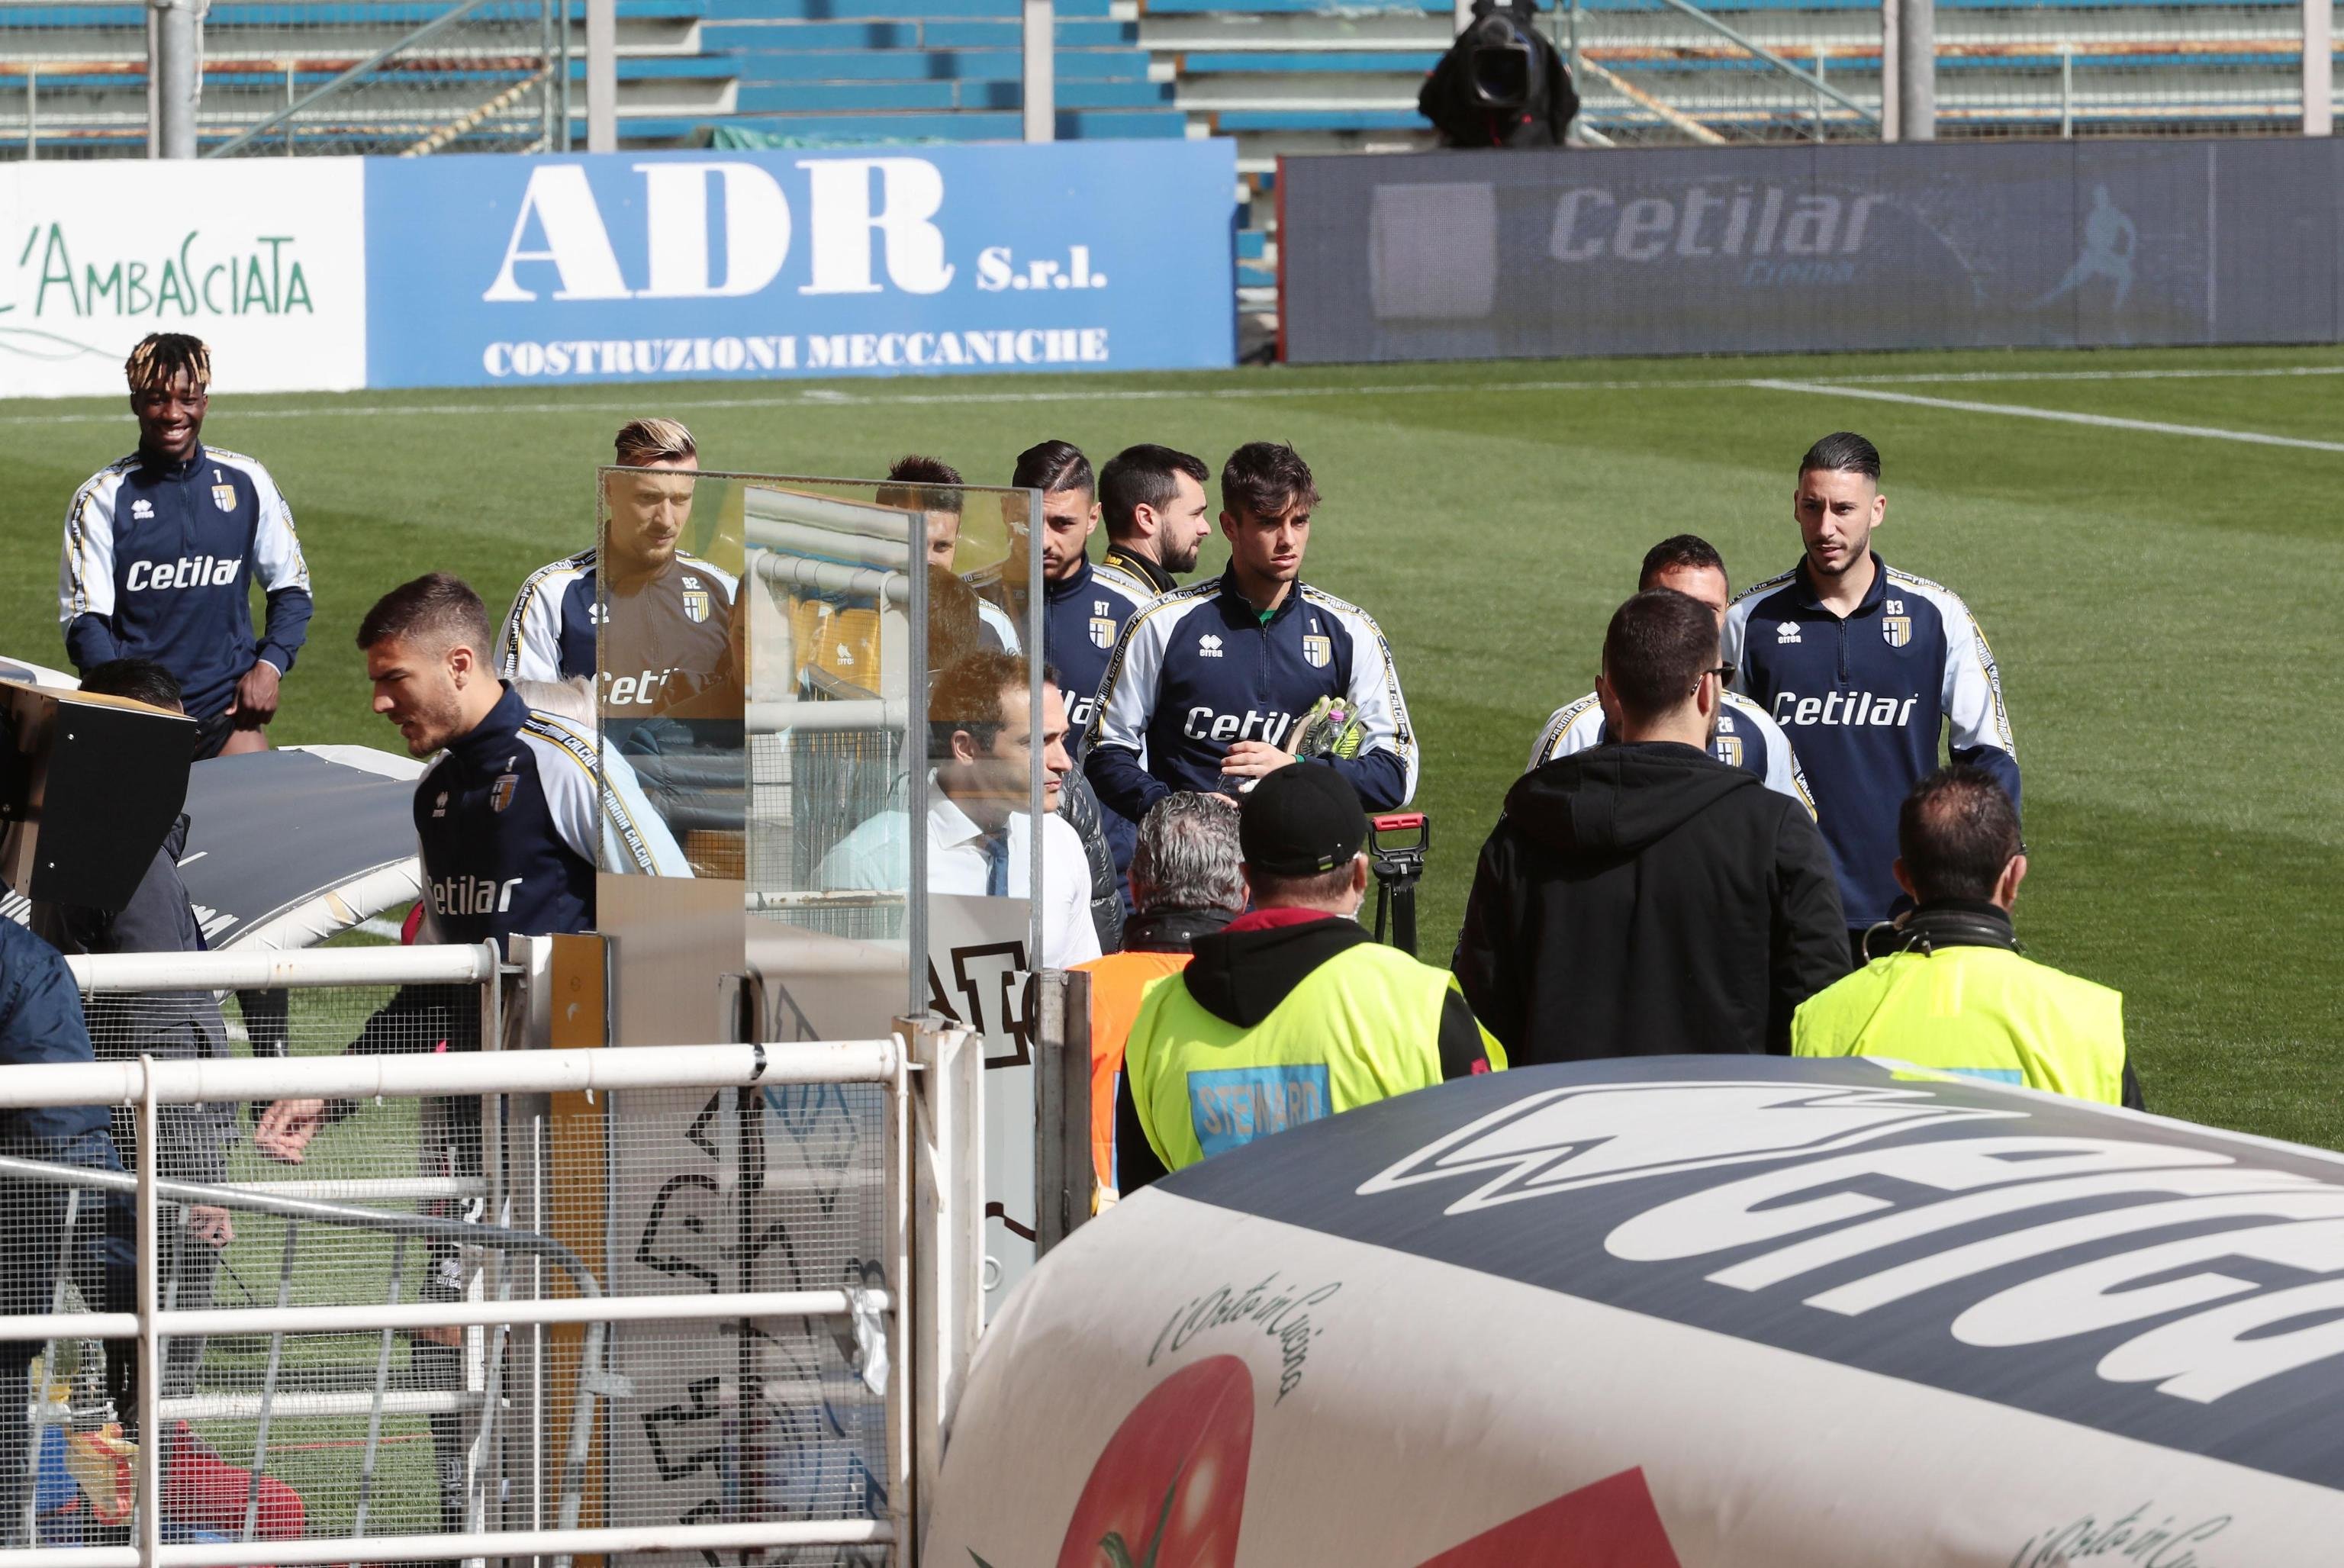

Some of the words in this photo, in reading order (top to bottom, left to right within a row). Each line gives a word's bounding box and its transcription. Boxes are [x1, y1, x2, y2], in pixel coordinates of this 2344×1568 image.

[482, 156, 955, 303] ADR
[976, 245, 1109, 292] S.r.l.
[1550, 186, 1888, 262] Cetilar
[0, 221, 314, 317] 'AMBASCIATA
[482, 334, 797, 378] COSTRUZIONI
[807, 327, 1109, 369] MECCANICHE
[213, 469, 223, 483] 1
[681, 577, 700, 590] 92
[1093, 600, 1109, 617] 97
[1309, 618, 1318, 633] 1
[1886, 600, 1904, 615] 93
[1199, 648, 1223, 658] errea
[1550, 708, 1577, 741] PARMA
[1718, 716, 1735, 733] 26
[1772, 689, 1919, 726] Cetilar
[1184, 707, 1302, 746] Cetil
[623, 827, 652, 868] CALCIO
[427, 874, 523, 916] etilar
[1199, 1080, 1321, 1136] STEWARD
